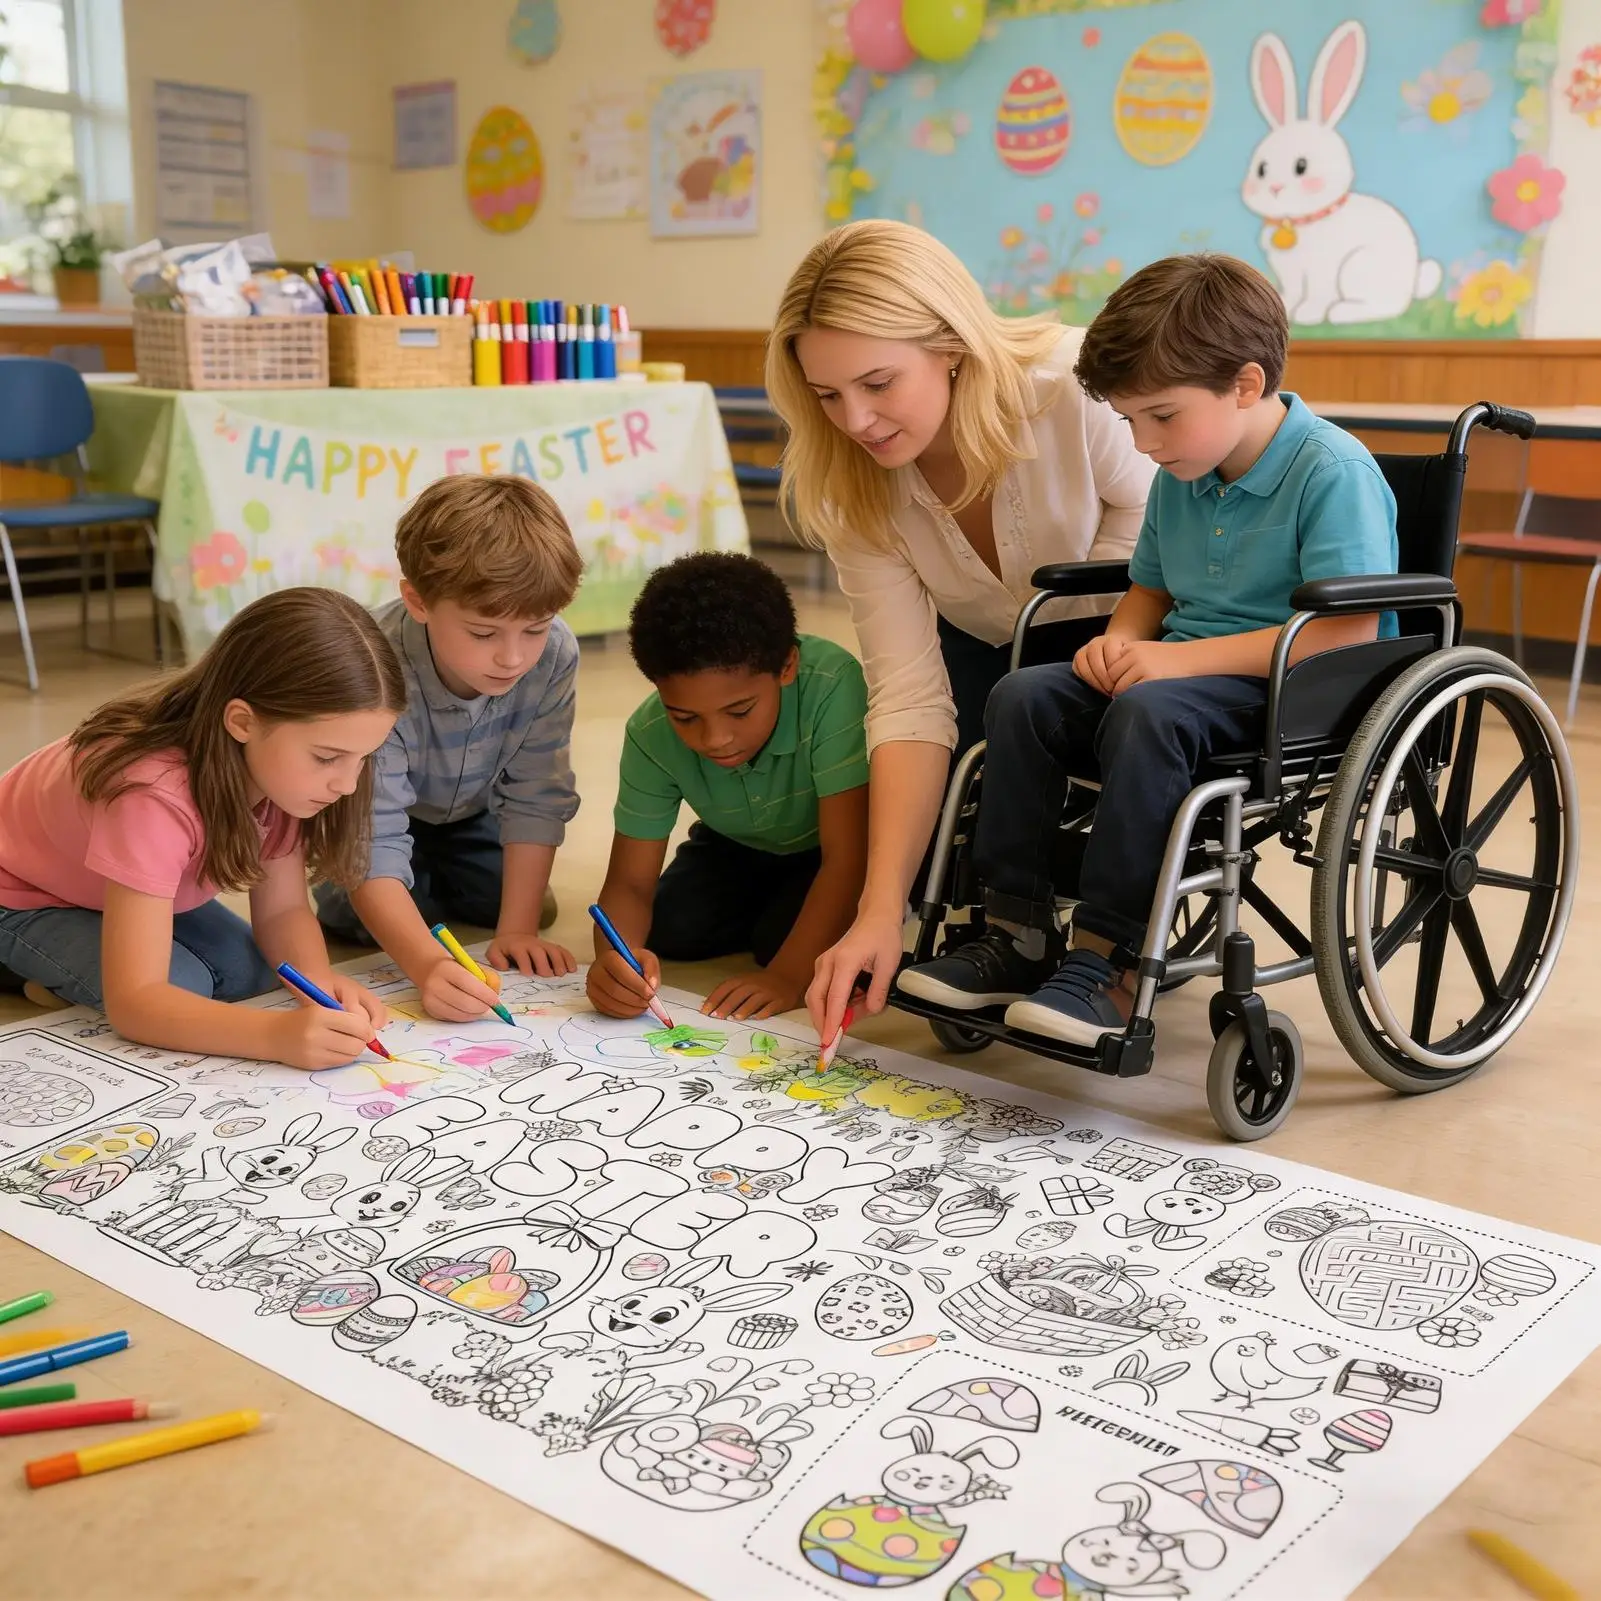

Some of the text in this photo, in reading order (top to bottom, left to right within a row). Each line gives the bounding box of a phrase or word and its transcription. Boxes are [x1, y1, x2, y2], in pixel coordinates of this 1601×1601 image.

[245, 425, 418, 499] HAPPY
[370, 1095, 818, 1278] EASTER
[498, 1062, 896, 1204] HAPPY
